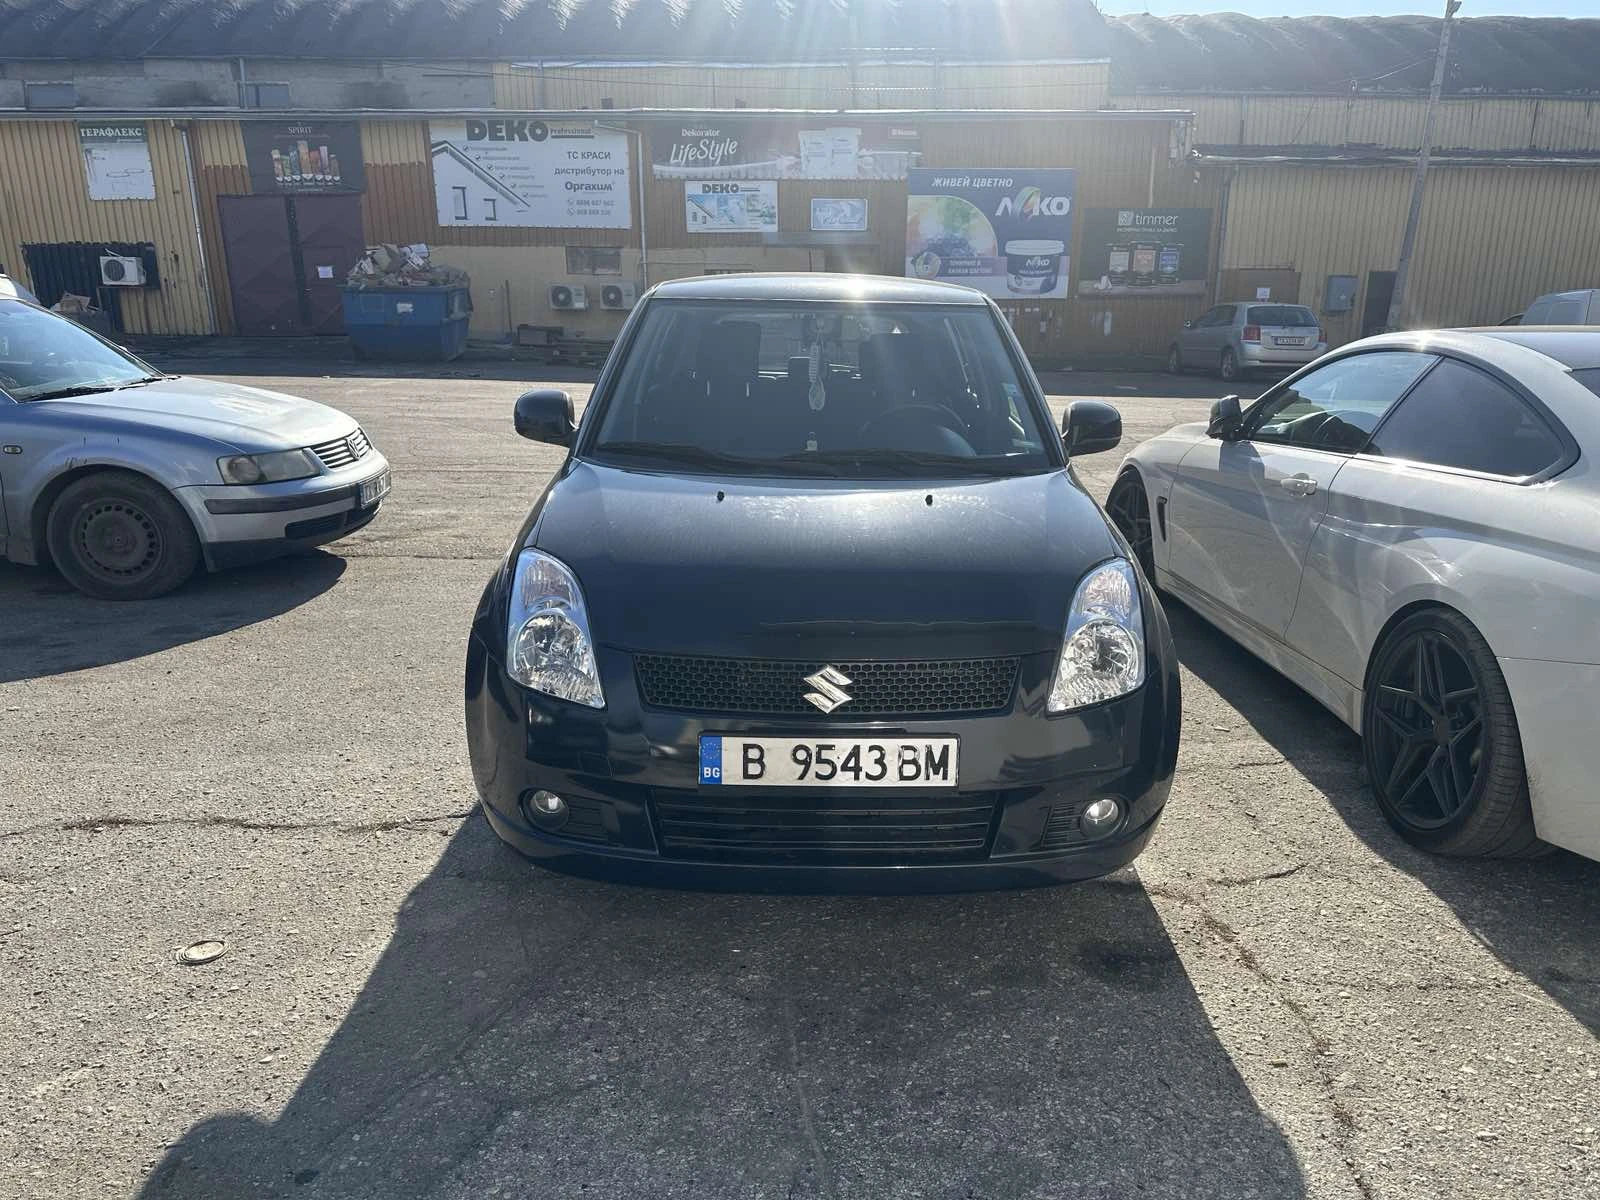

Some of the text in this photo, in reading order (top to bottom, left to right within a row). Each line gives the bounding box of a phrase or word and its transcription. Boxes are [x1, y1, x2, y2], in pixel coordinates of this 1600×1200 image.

[287, 126, 313, 135] SPIRIT
[466, 119, 549, 142] DEKO
[681, 128, 721, 137] Dekorator
[567, 151, 611, 160] ТС КРАСИ
[670, 137, 738, 166] LifeStyle
[553, 166, 625, 177] дистрибутор на
[931, 176, 1014, 189] ЖИВЕЙ ЦВЕТНО
[702, 183, 739, 194] DEKO
[1135, 212, 1178, 225] timmer
[742, 743, 950, 782] B 9543 BM
[703, 767, 720, 778] BG
